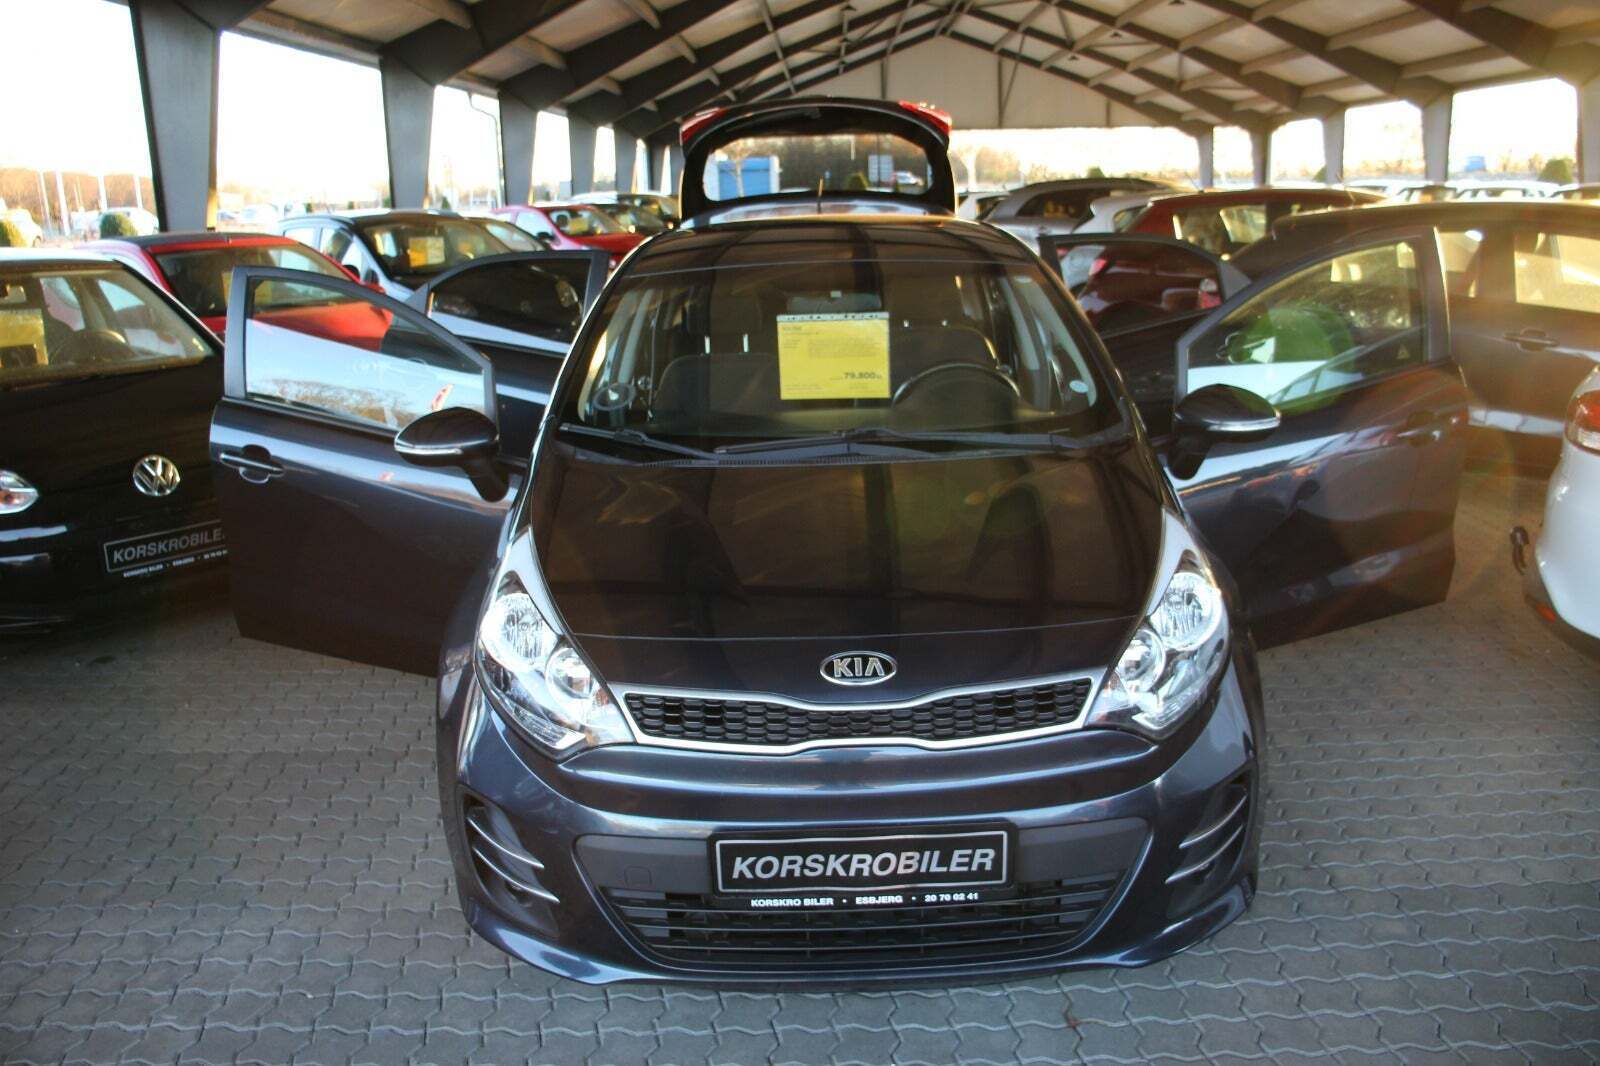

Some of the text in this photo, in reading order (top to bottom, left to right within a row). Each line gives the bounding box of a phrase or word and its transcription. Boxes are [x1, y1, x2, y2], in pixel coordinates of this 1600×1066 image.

[113, 527, 225, 563] KORSKROBILE
[833, 657, 885, 678] KIA
[731, 848, 996, 880] KORSKROBILER
[750, 898, 801, 908] KORSKRO
[803, 897, 834, 906] BILER
[855, 894, 904, 905] ESBJERG
